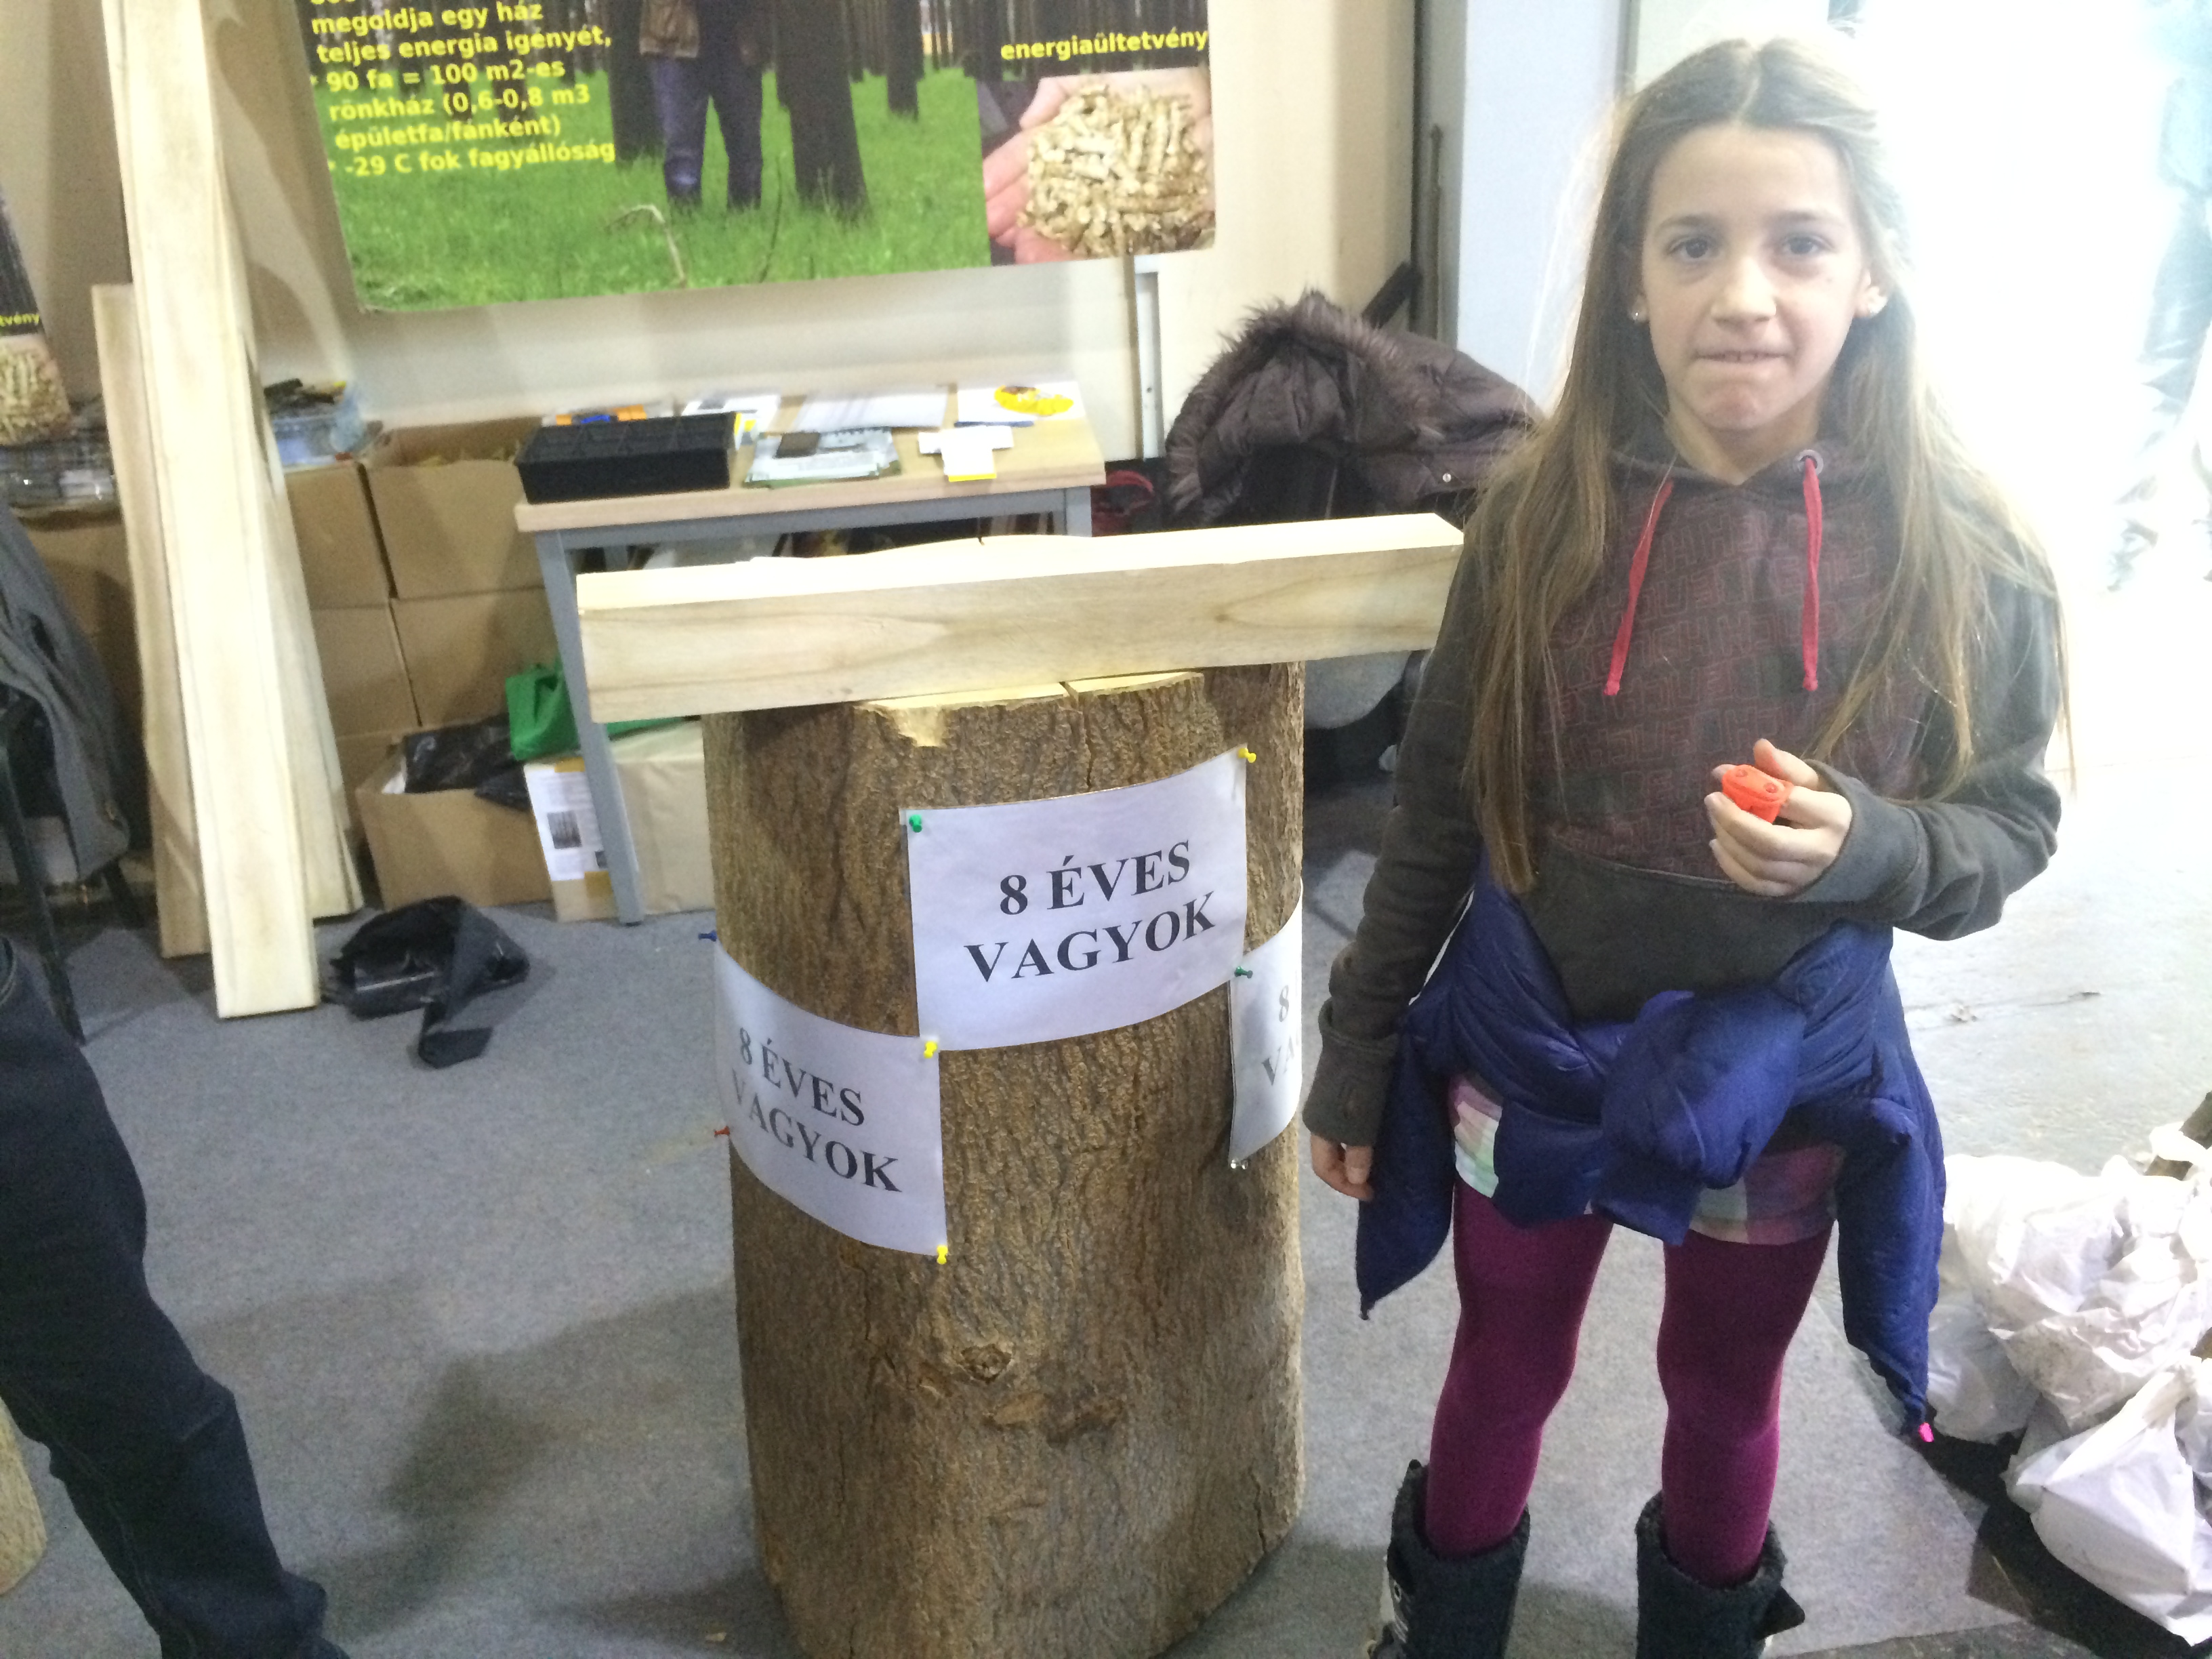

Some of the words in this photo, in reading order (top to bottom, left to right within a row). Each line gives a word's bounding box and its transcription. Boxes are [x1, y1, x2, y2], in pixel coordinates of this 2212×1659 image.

[312, 7, 434, 37] megoldja
[442, 7, 489, 30] egy
[496, 0, 544, 22] ház
[316, 40, 391, 66] teljes
[398, 32, 498, 59] energia
[506, 24, 612, 55] igényét,
[1001, 26, 1209, 61] energiaültetvény
[327, 70, 359, 91] 90
[367, 68, 394, 89] fa
[430, 62, 478, 85] 100
[486, 58, 565, 81] m2-es
[552, 83, 590, 104] m3
[345, 155, 386, 176] -29
[394, 153, 412, 173] C
[419, 150, 462, 171] fok
[469, 138, 615, 170] fagyállóság
[1000, 874, 1028, 916] 8
[1046, 839, 1191, 910] ÉVES
[963, 891, 1216, 982] VAGYOK
[1279, 985, 1290, 1023] 8
[739, 1027, 753, 1065] 8
[760, 1038, 865, 1126] ÉVES
[732, 1067, 903, 1193] VAGYOK
